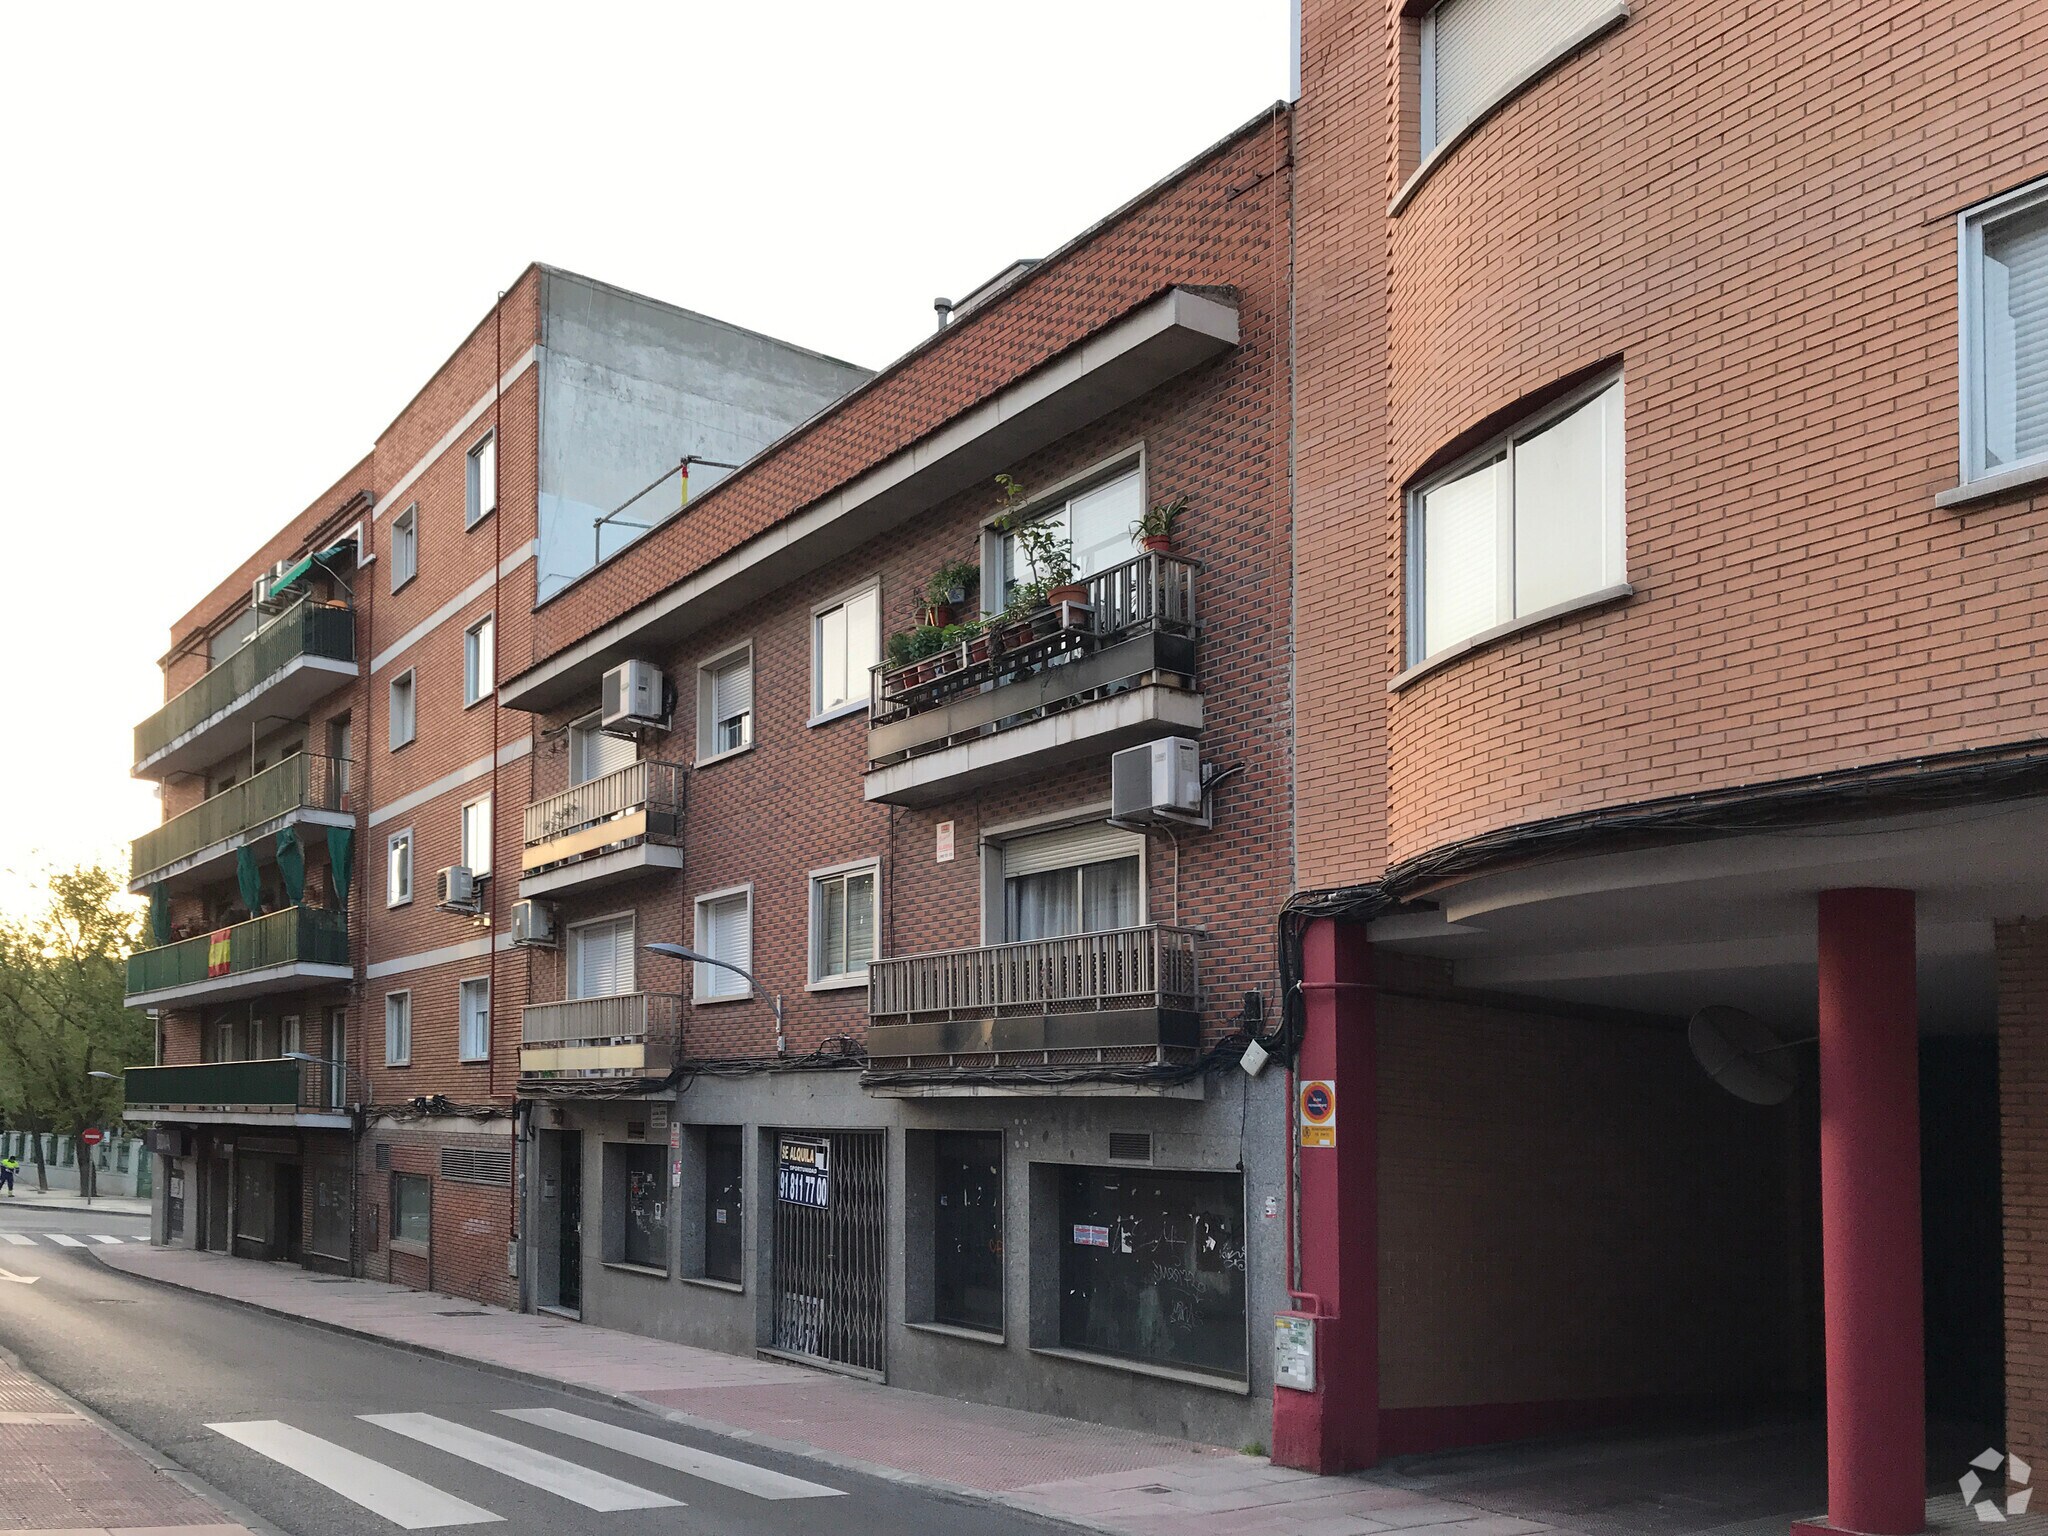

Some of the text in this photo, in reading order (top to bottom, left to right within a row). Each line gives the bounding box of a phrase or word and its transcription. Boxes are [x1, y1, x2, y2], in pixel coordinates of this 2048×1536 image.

[782, 1145, 814, 1164] SE ALQUILA
[780, 1171, 827, 1206] 91 811 77 00
